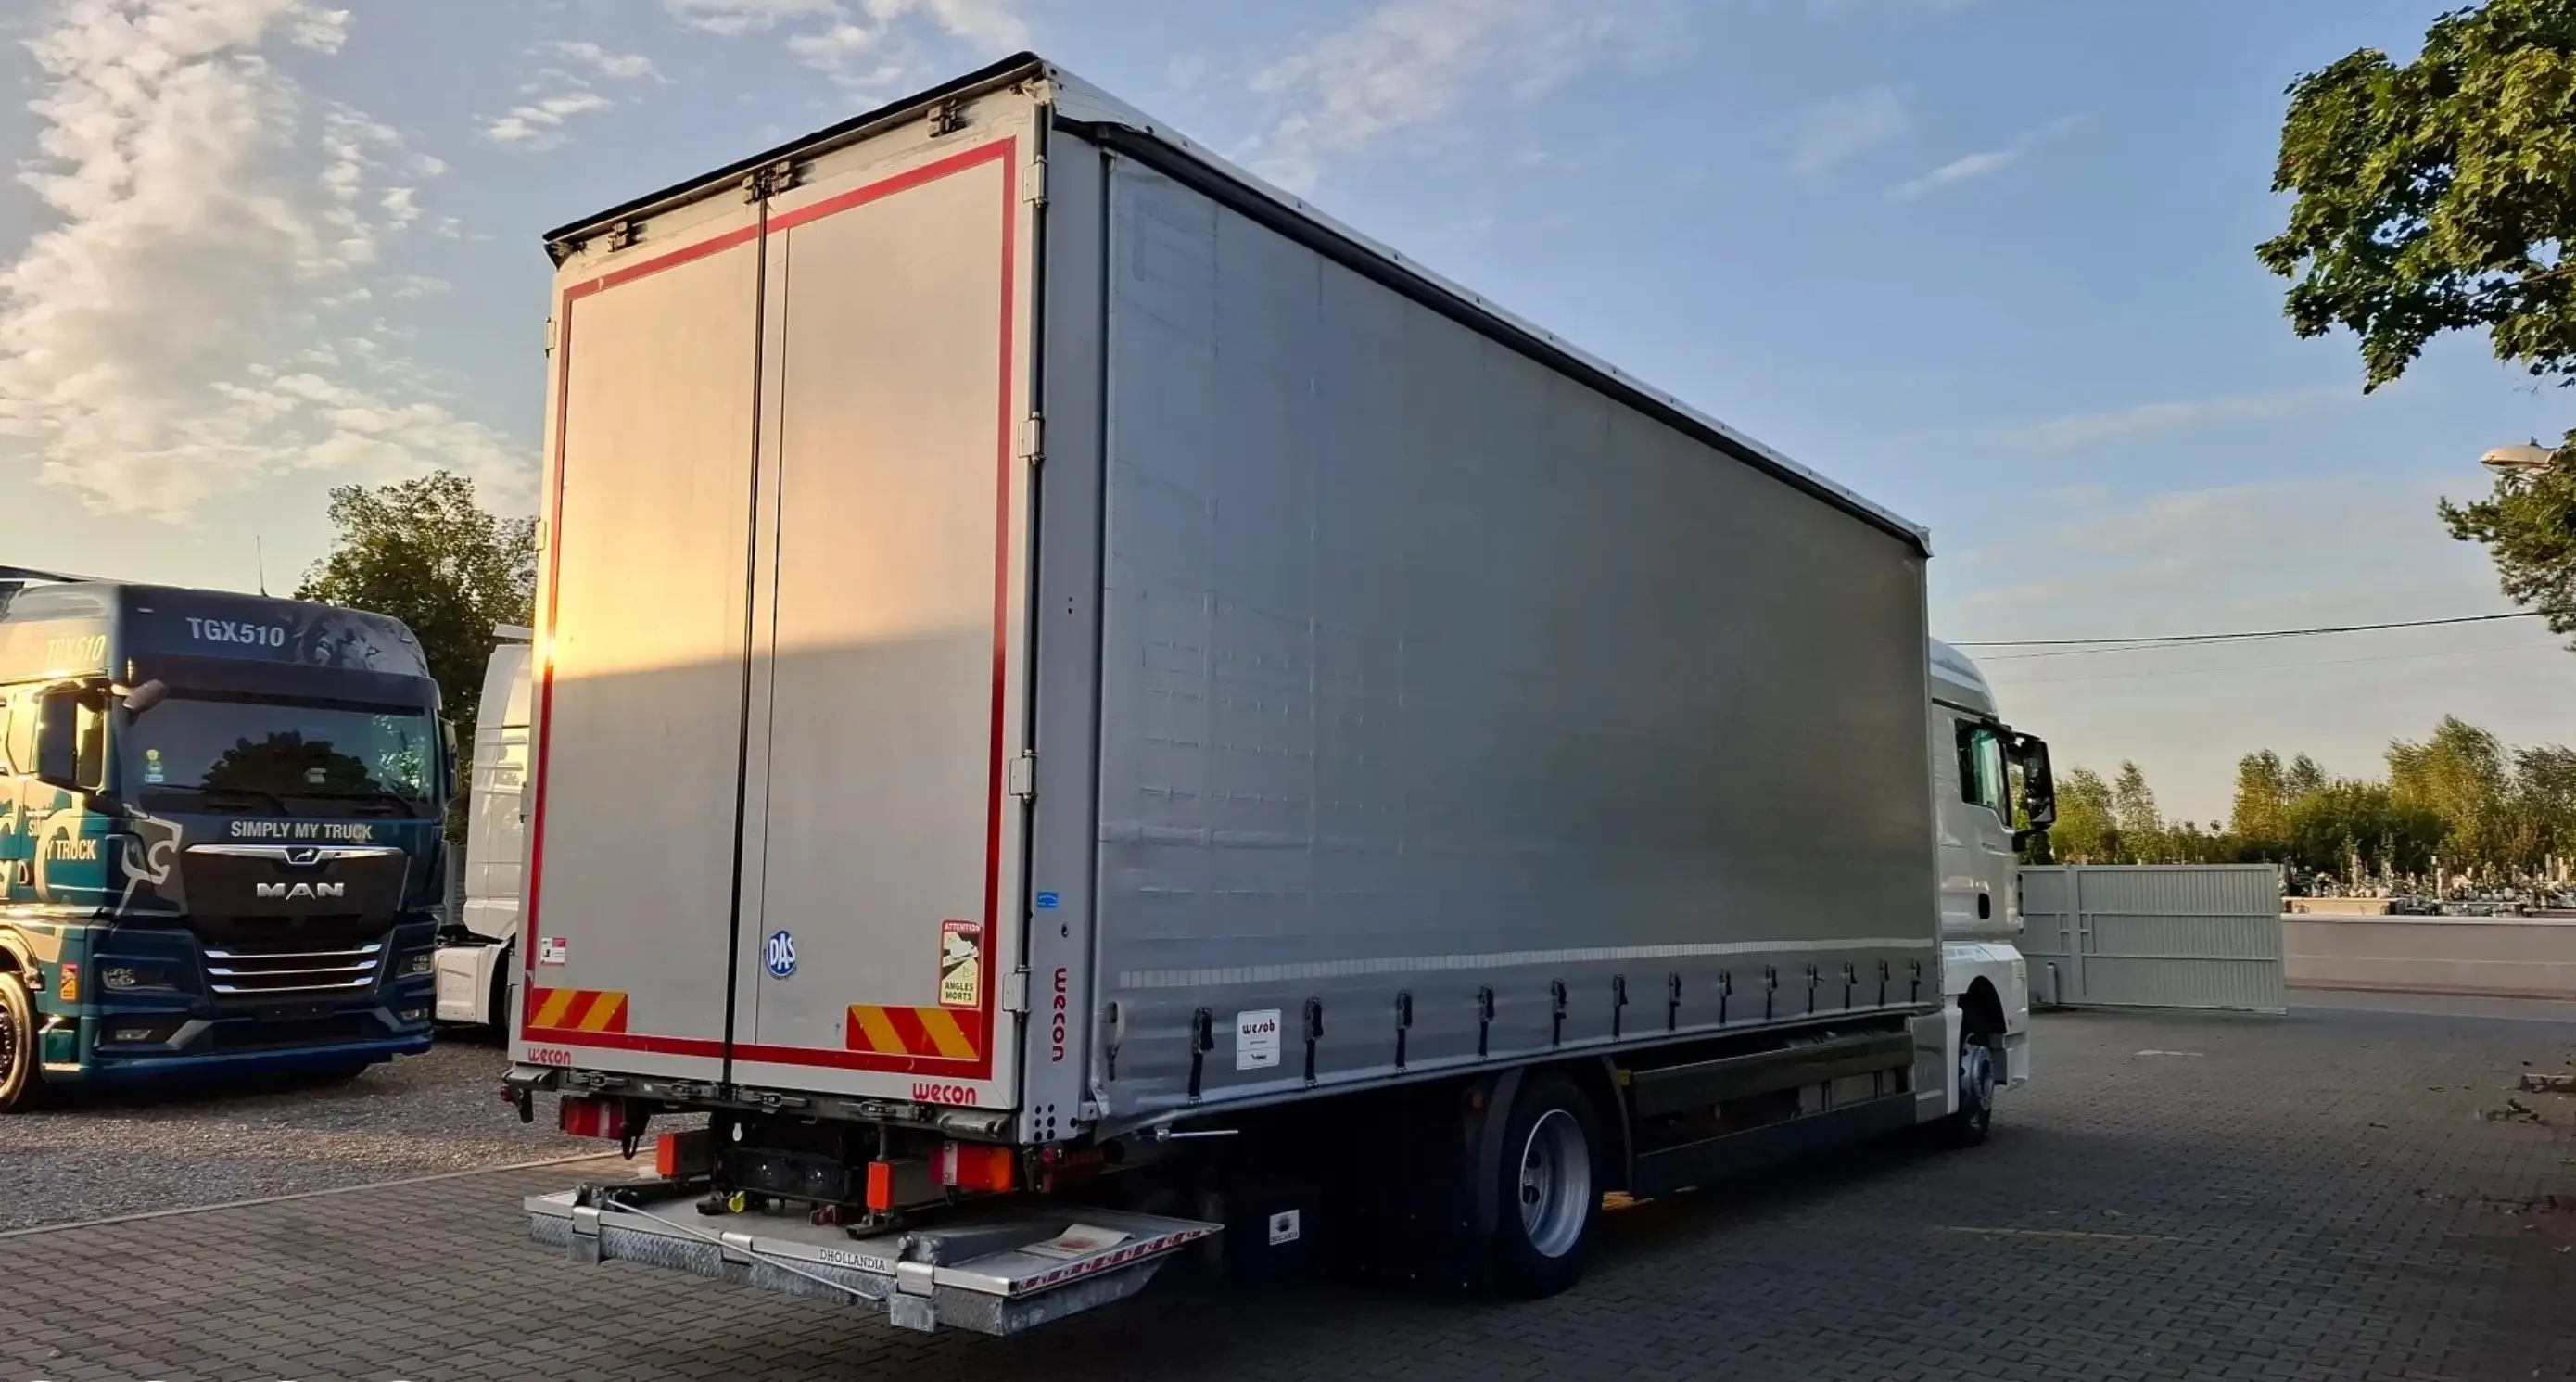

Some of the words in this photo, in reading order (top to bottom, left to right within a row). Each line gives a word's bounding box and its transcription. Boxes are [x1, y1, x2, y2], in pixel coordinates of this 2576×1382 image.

[186, 617, 285, 647] TGX510
[230, 821, 290, 838] SIMPLY
[294, 823, 319, 839] MY
[323, 823, 373, 840] TRUCK
[257, 882, 344, 900] MAN
[944, 922, 981, 932] ATTENTION
[770, 932, 795, 970] DAS
[945, 982, 974, 992] ANGLES
[945, 991, 972, 1001] MORTS
[1052, 968, 1067, 1062] wecon
[528, 1047, 571, 1066] wecon
[912, 1082, 977, 1105] wecon
[819, 1249, 886, 1271] DHOLLANDIA
